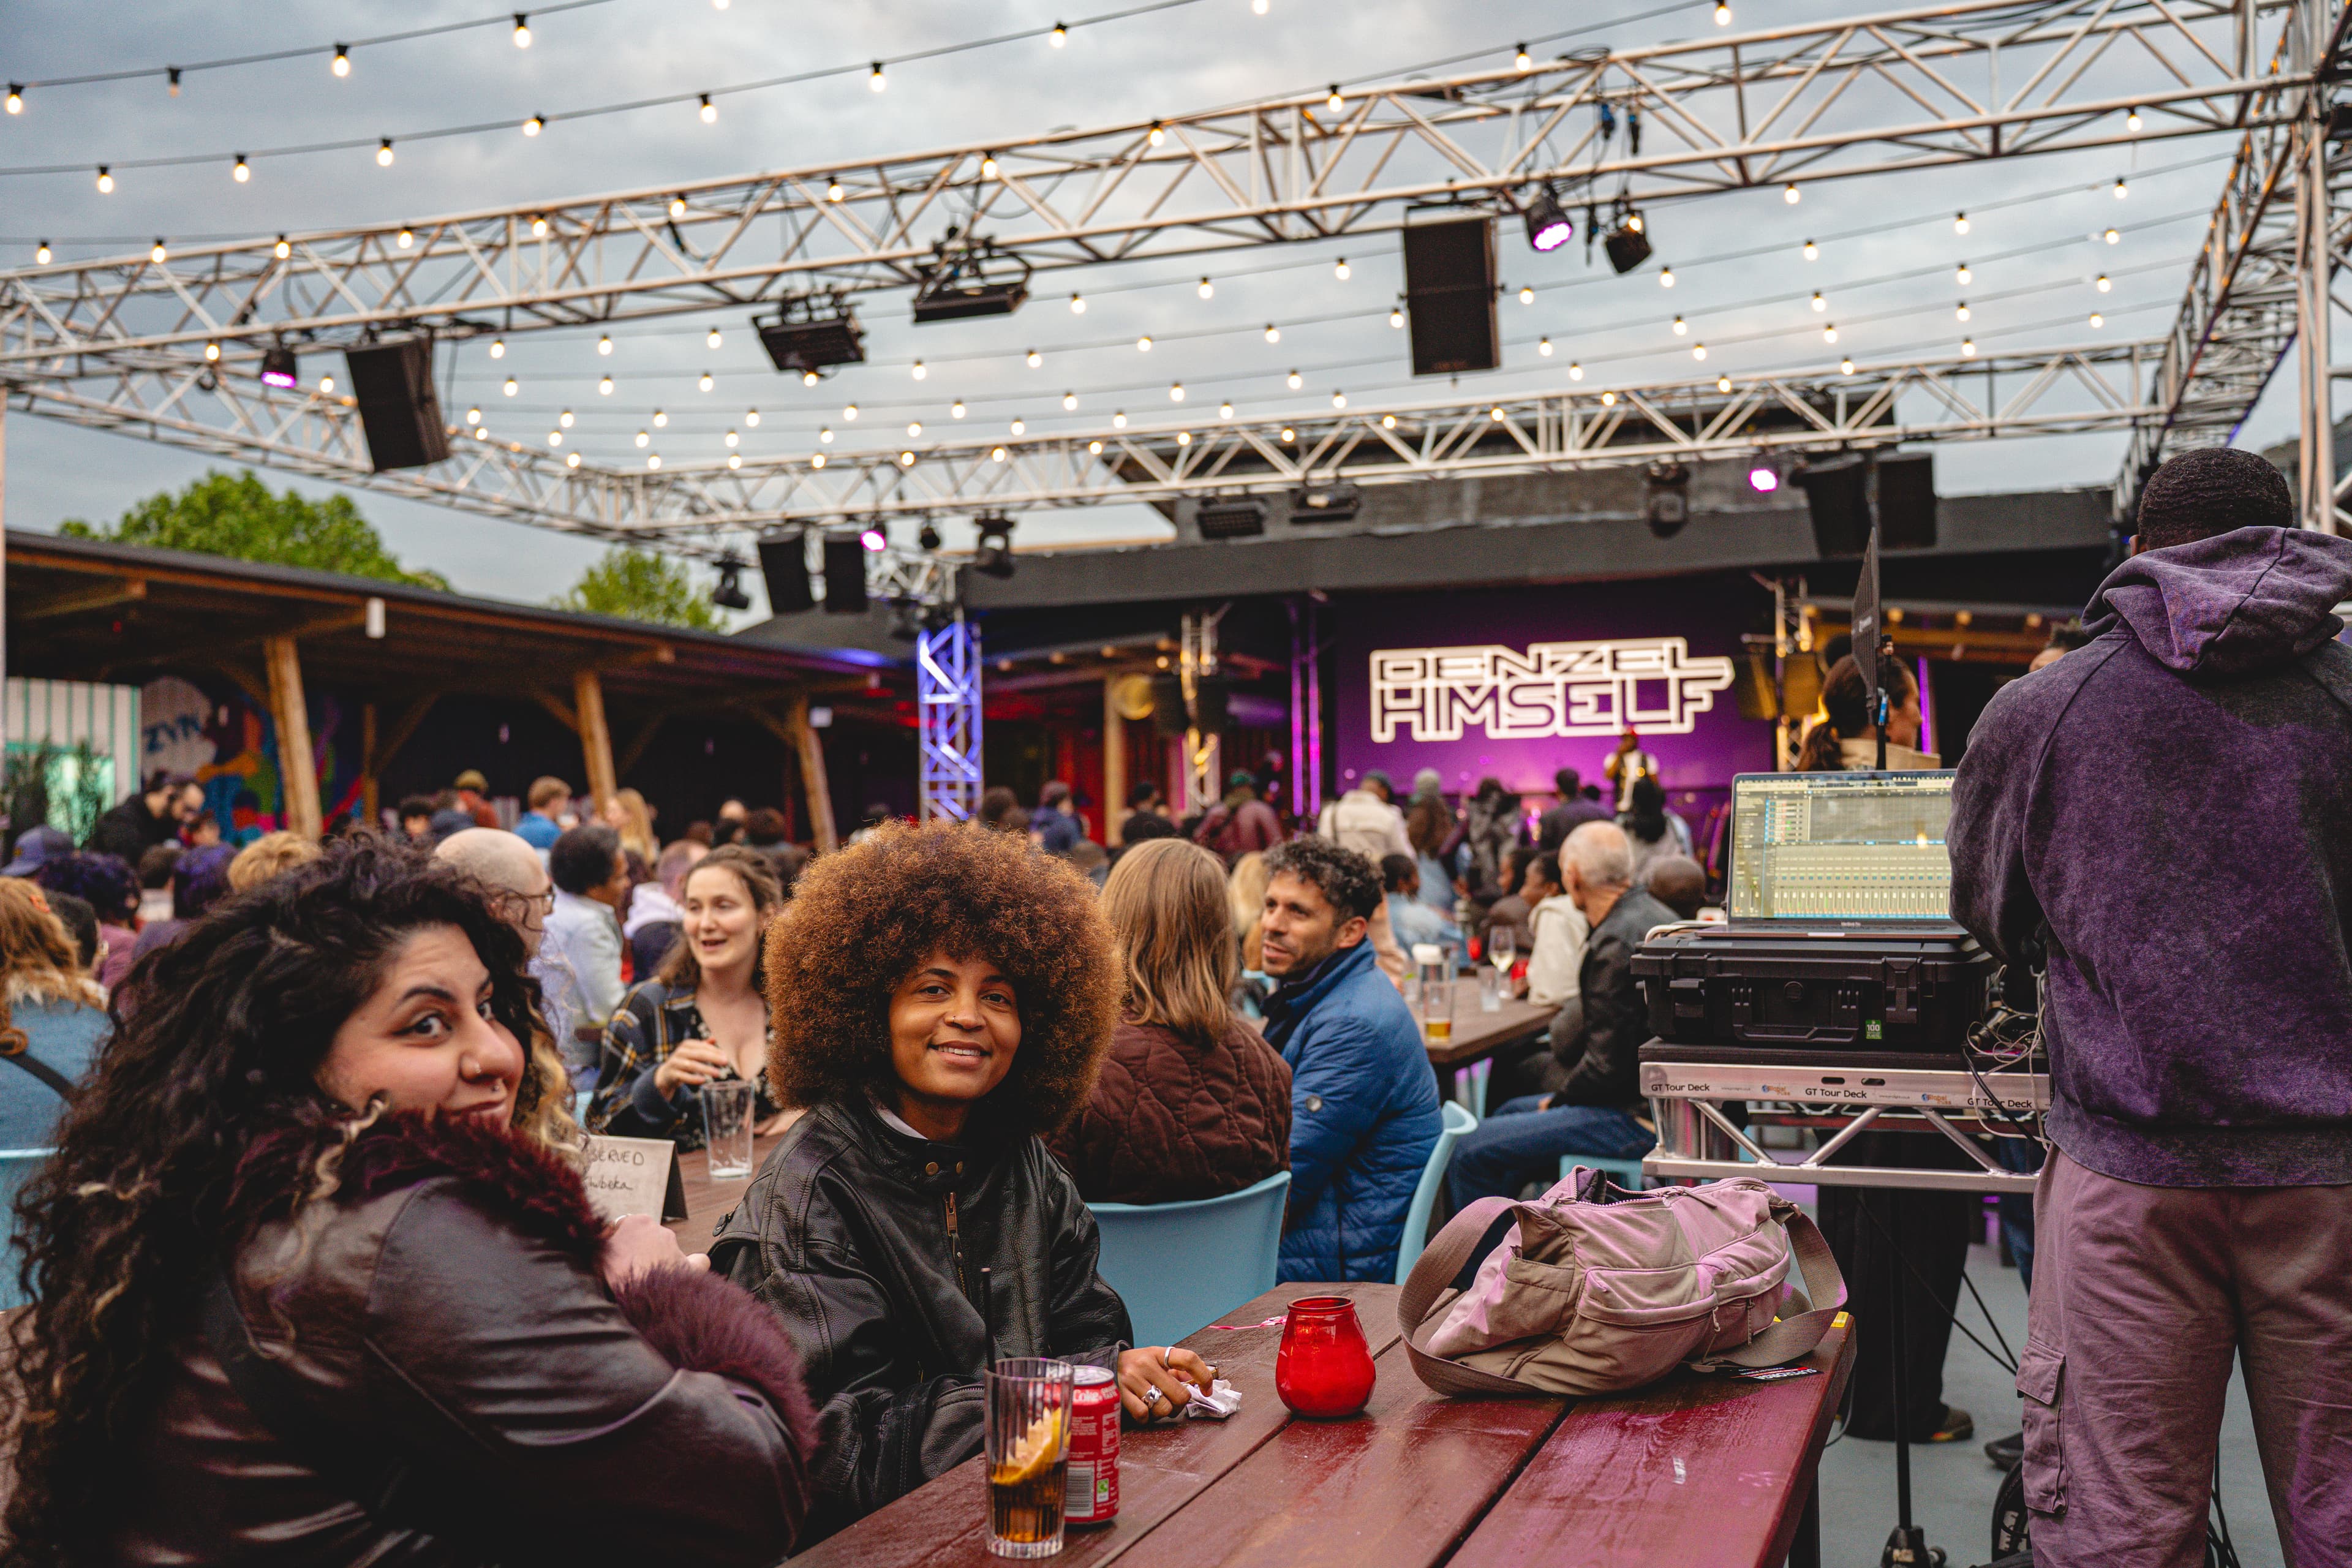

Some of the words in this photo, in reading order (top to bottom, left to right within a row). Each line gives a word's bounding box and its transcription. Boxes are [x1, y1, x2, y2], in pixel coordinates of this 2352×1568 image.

[1370, 673, 1735, 743] HIMSELF
[1820, 1088, 1841, 1097] Tour
[1844, 1090, 1867, 1099] Deck
[2008, 1099, 2032, 1108] Deck
